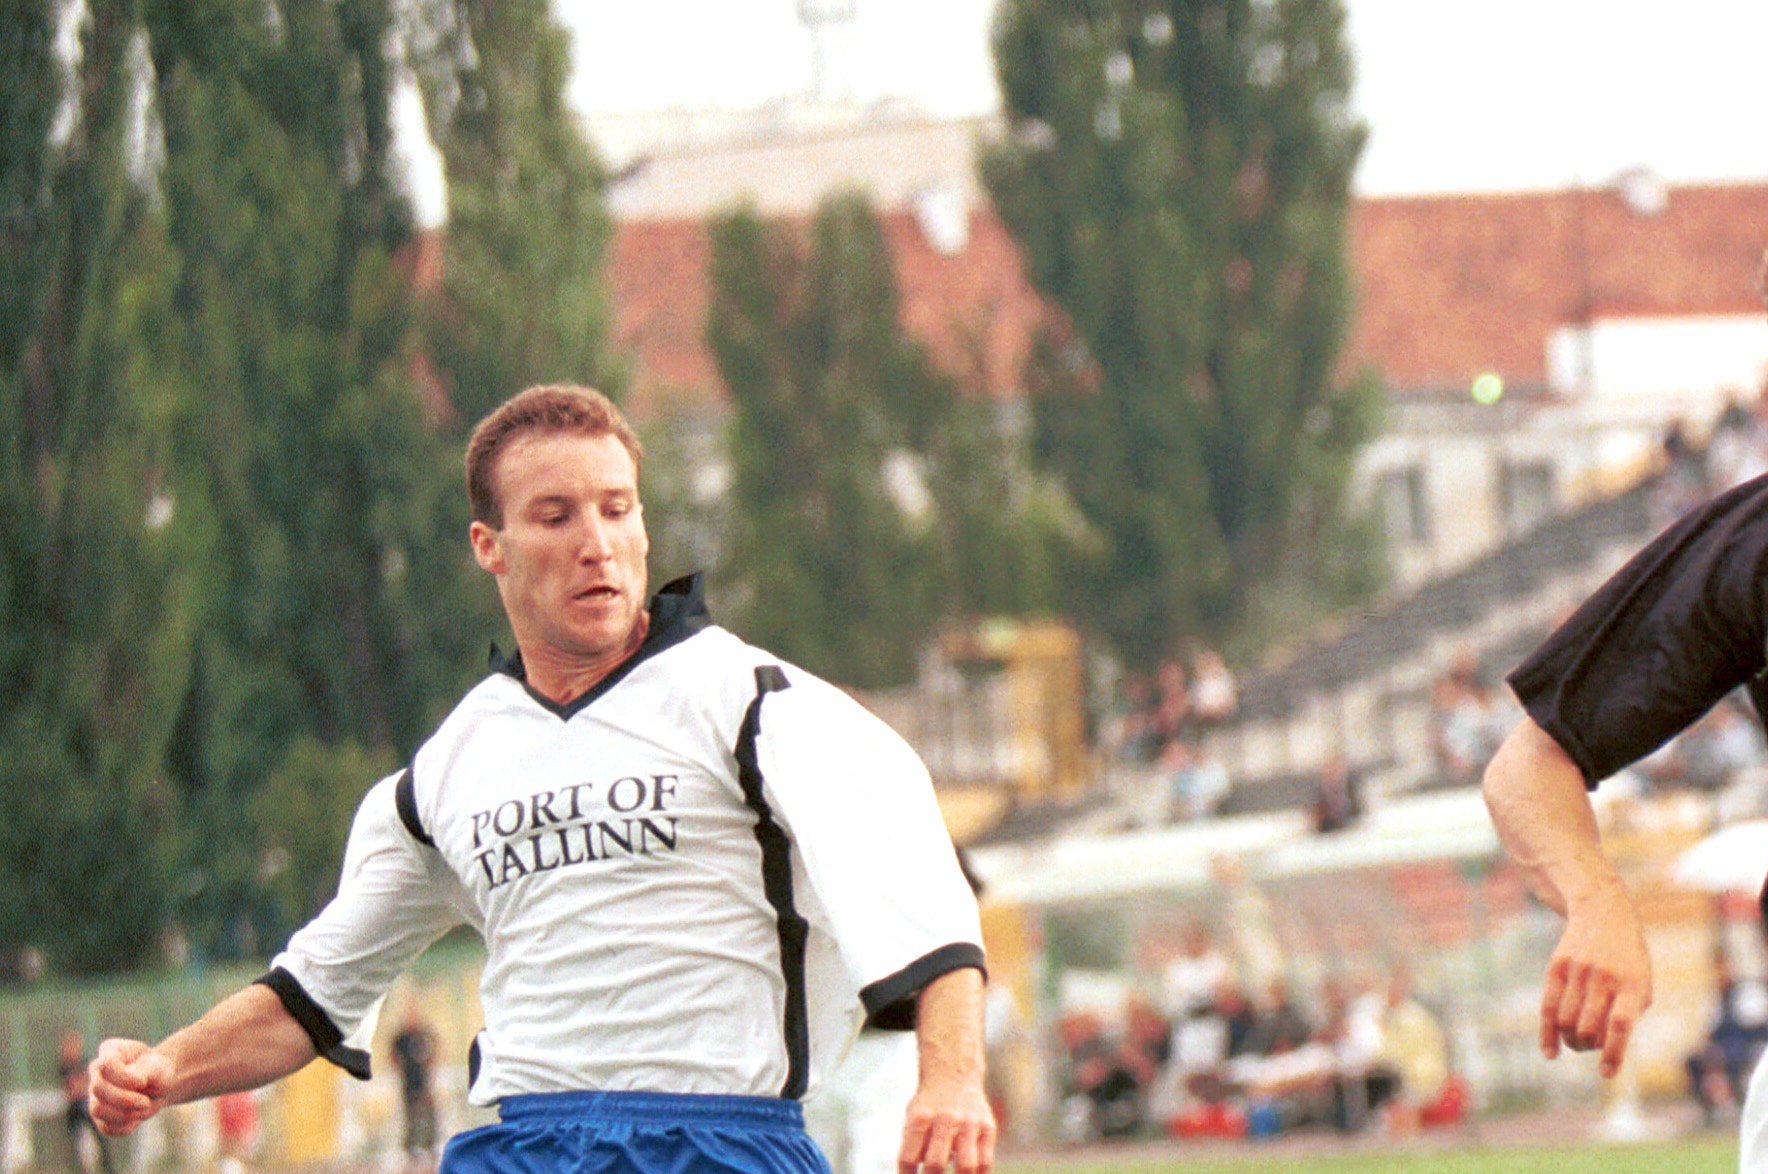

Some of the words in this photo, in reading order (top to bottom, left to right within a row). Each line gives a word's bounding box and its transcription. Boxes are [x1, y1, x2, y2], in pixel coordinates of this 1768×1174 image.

[470, 782, 593, 850] PORT
[607, 774, 680, 812] OF
[473, 816, 680, 891] TALLINN
